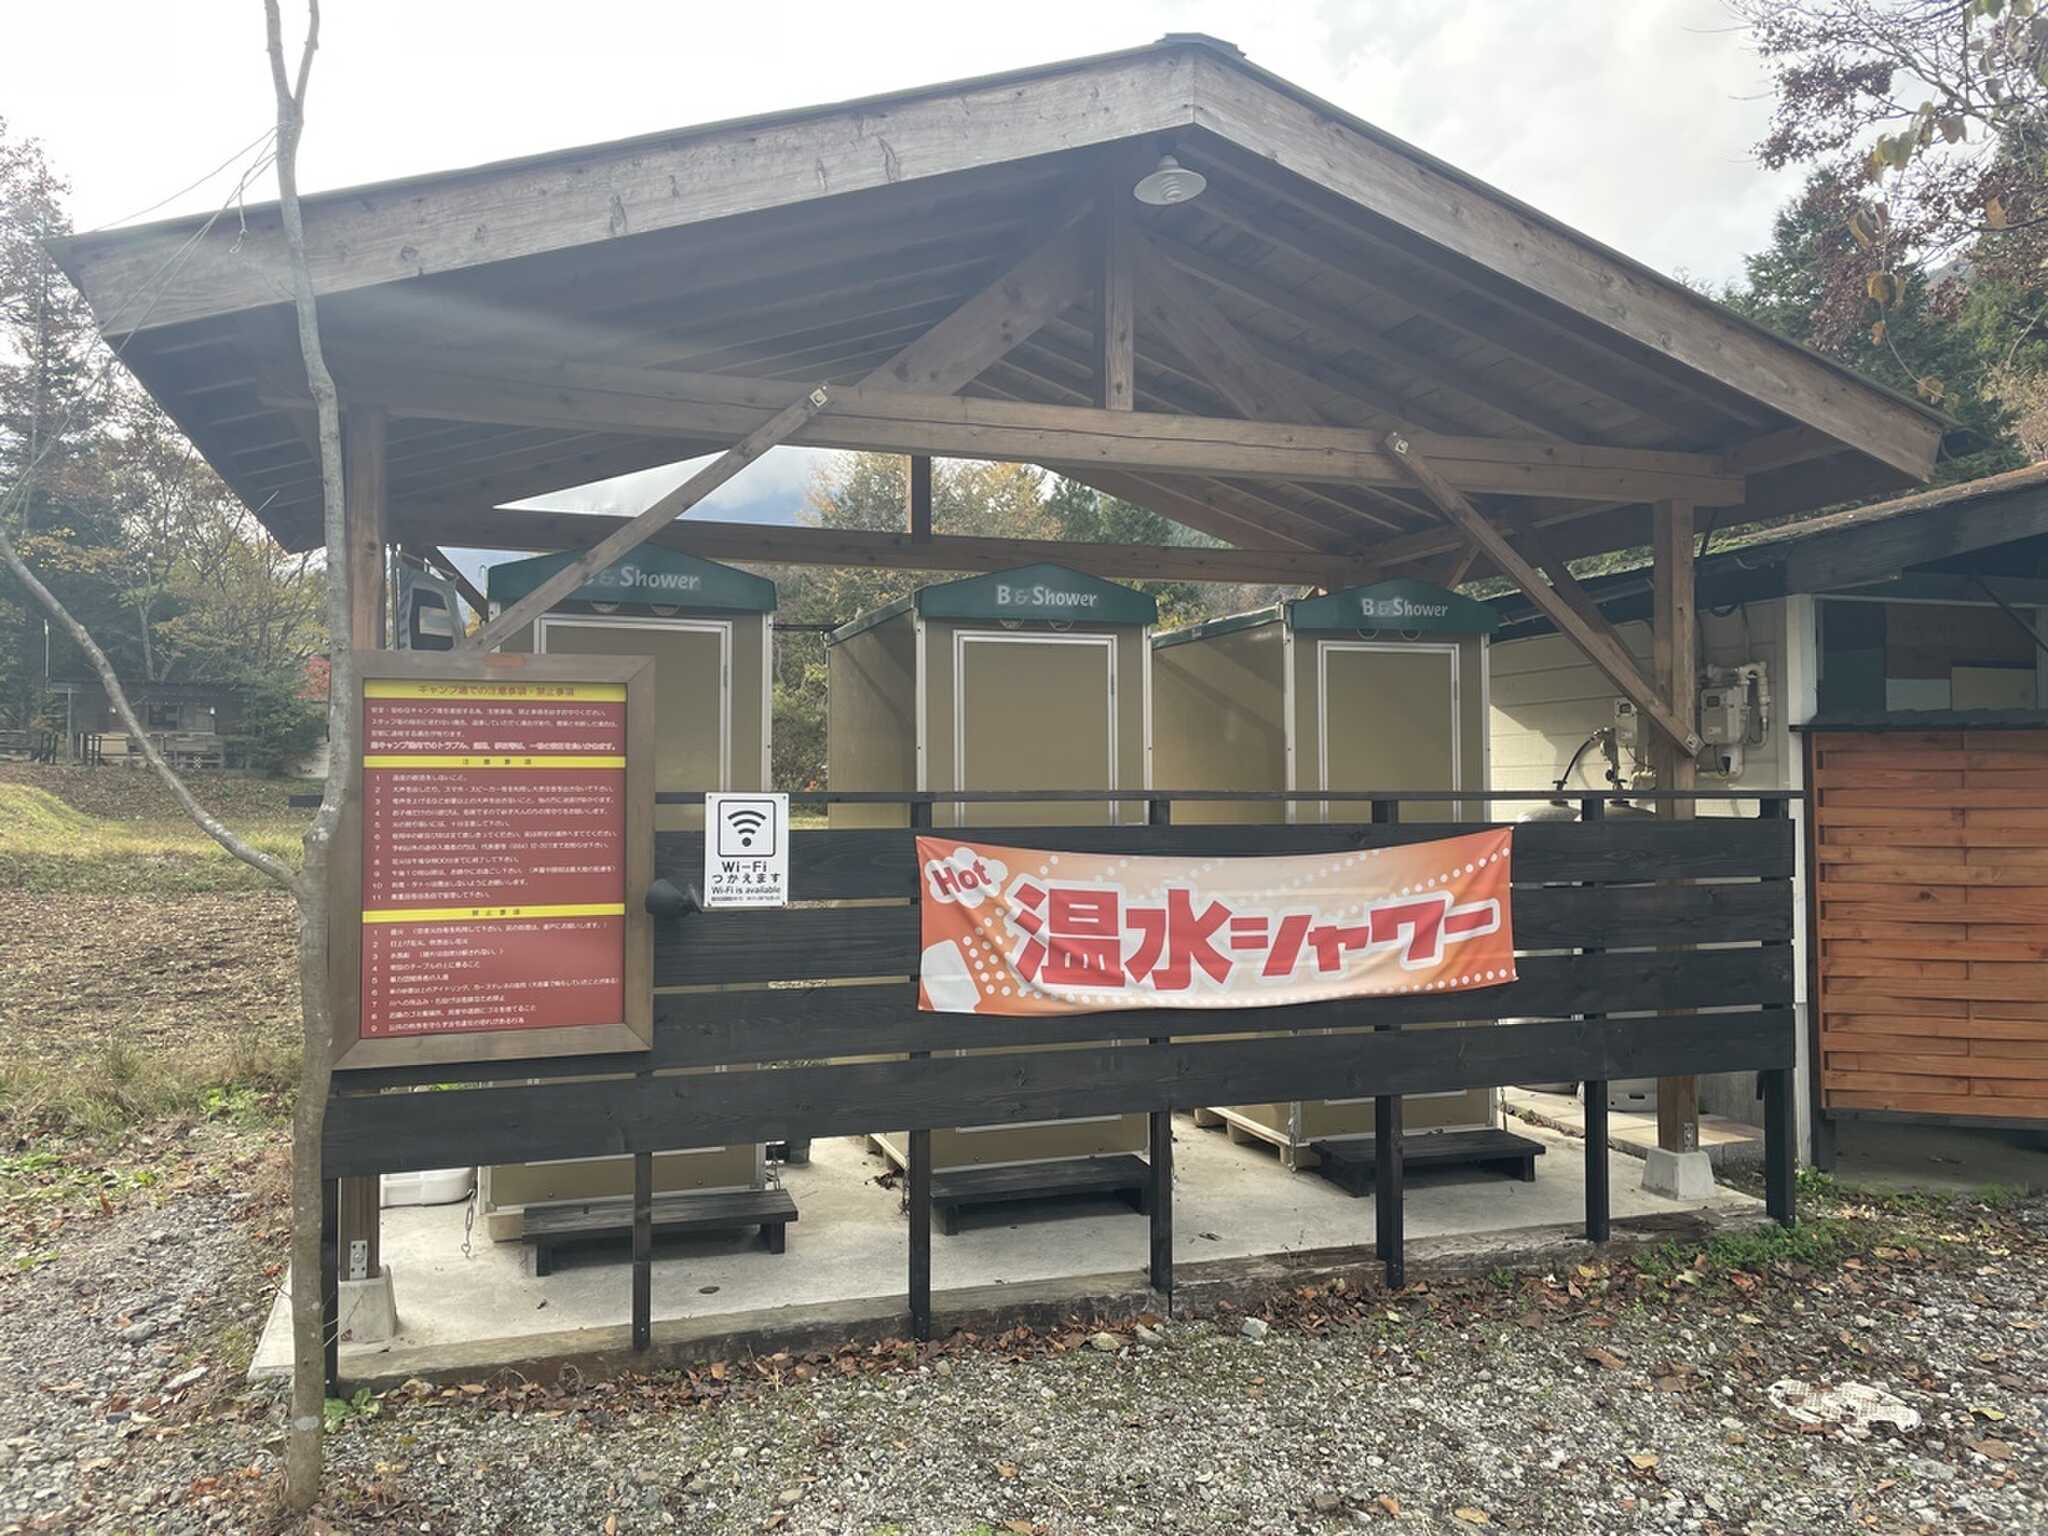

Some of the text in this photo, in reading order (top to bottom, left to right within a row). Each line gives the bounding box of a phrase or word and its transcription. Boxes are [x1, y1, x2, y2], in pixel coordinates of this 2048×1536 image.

[620, 566, 700, 590] Shower
[997, 585, 1011, 605] B
[1032, 586, 1097, 607] Shower
[1361, 598, 1374, 616] B
[1392, 598, 1449, 617] Shower
[721, 861, 767, 872] Wi-Fi
[712, 873, 781, 884] つかえます
[931, 859, 992, 897] Hot
[711, 886, 782, 895] Wi-Fi is available
[1012, 883, 1496, 992] 温水シャワー
